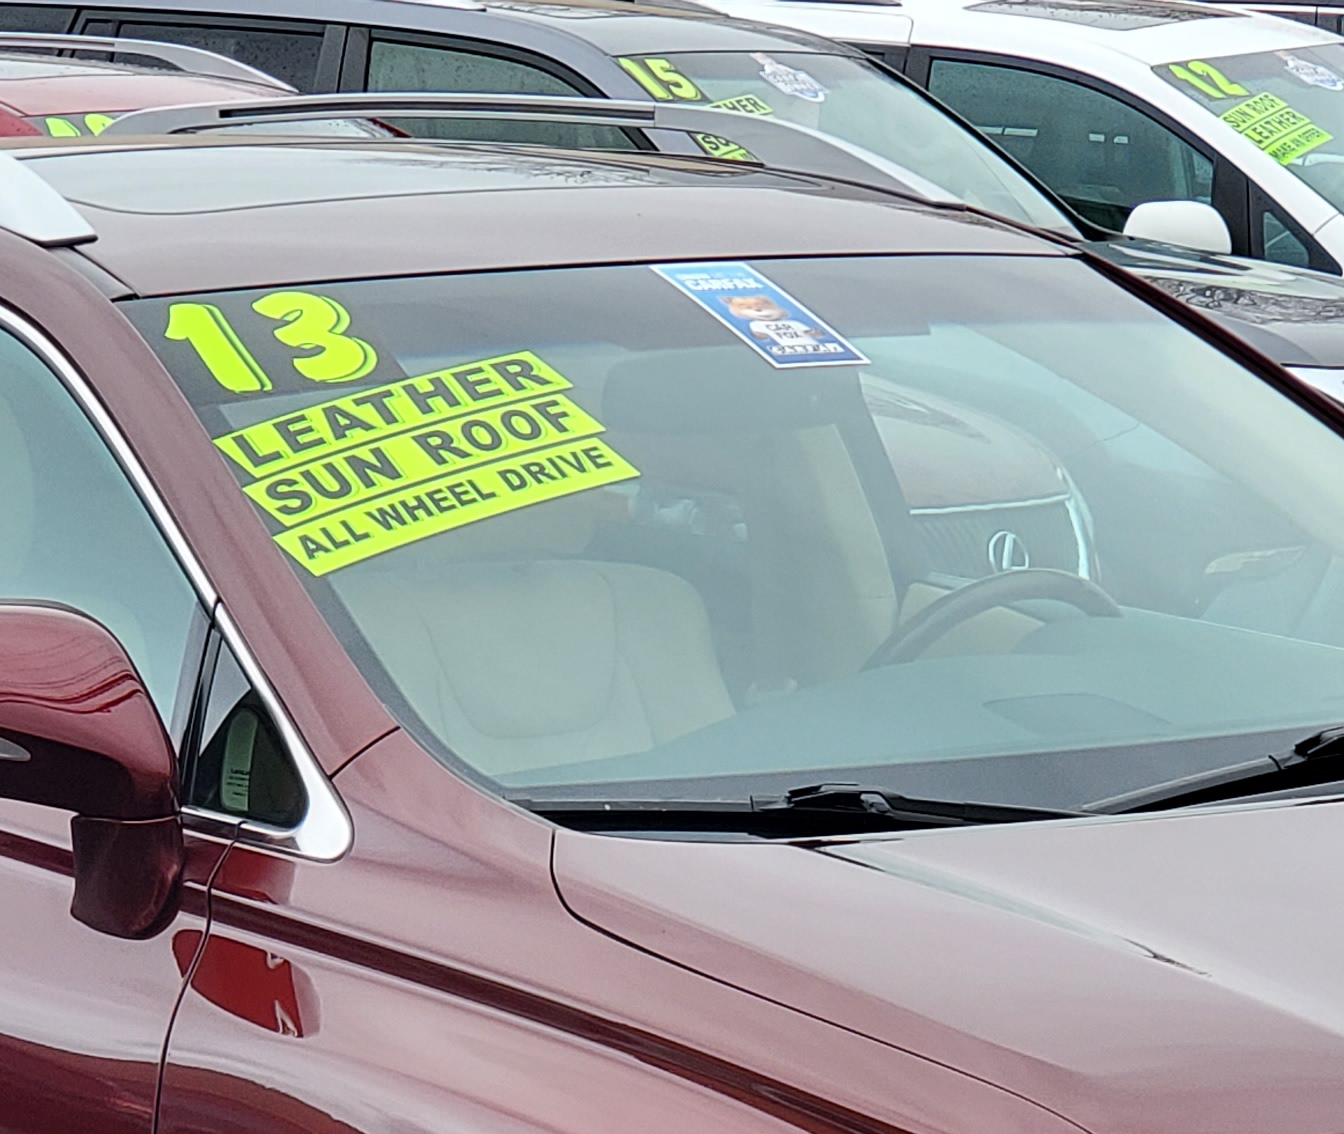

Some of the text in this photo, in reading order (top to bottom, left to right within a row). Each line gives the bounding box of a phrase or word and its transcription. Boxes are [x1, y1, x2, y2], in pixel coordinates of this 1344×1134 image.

[617, 57, 703, 100] 15
[1168, 61, 1250, 98] 12
[1244, 110, 1305, 145] LEATHER
[684, 278, 765, 292] CARFAX
[165, 291, 379, 392] 13
[232, 356, 553, 468] LEATHER
[263, 398, 580, 517] SUN ROOF
[296, 444, 614, 561] ALL WHEEL DRIVE
